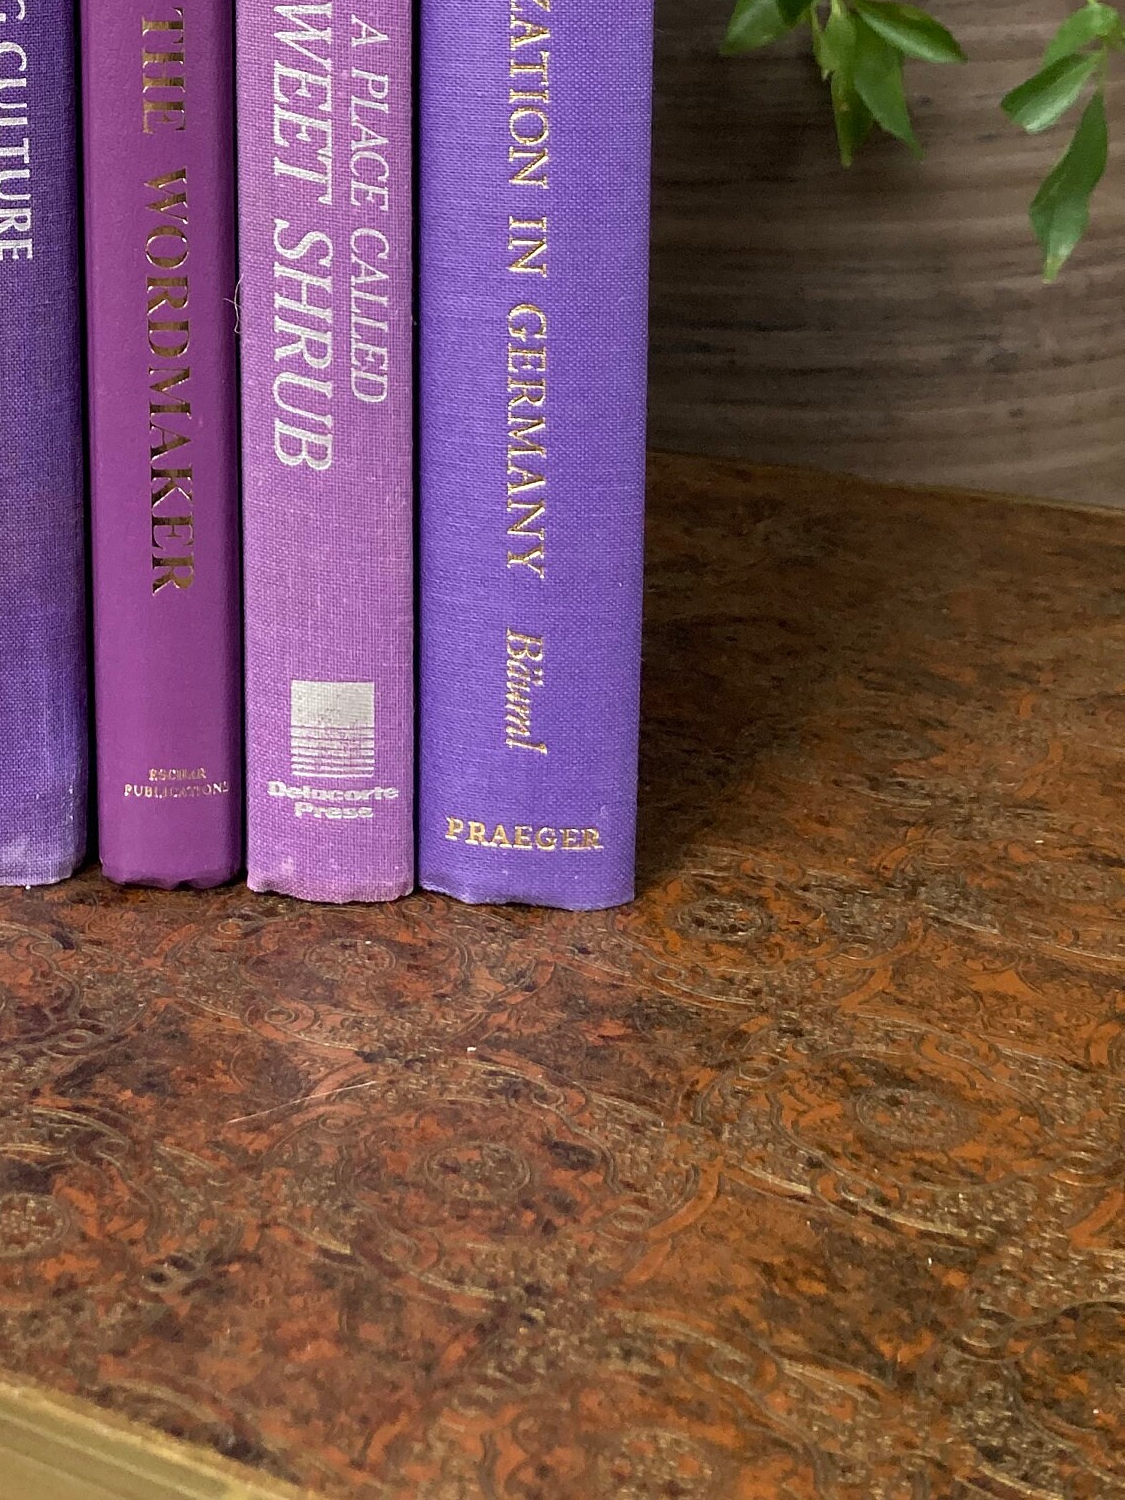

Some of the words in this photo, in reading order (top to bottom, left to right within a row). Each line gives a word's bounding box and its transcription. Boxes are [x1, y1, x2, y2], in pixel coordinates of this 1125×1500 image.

[141, 6, 186, 135] THE
[350, 13, 390, 47] A
[350, 67, 390, 212] PLACE
[507, 215, 548, 279] IN
[273, 218, 334, 472] SHRUB
[350, 227, 390, 404] CALLED
[143, 167, 194, 597] WORDMAKER
[506, 302, 548, 579] GERMANY
[266, 780, 400, 800] Delacorte
[293, 801, 374, 819] Press
[444, 816, 605, 852] PRAEGER
